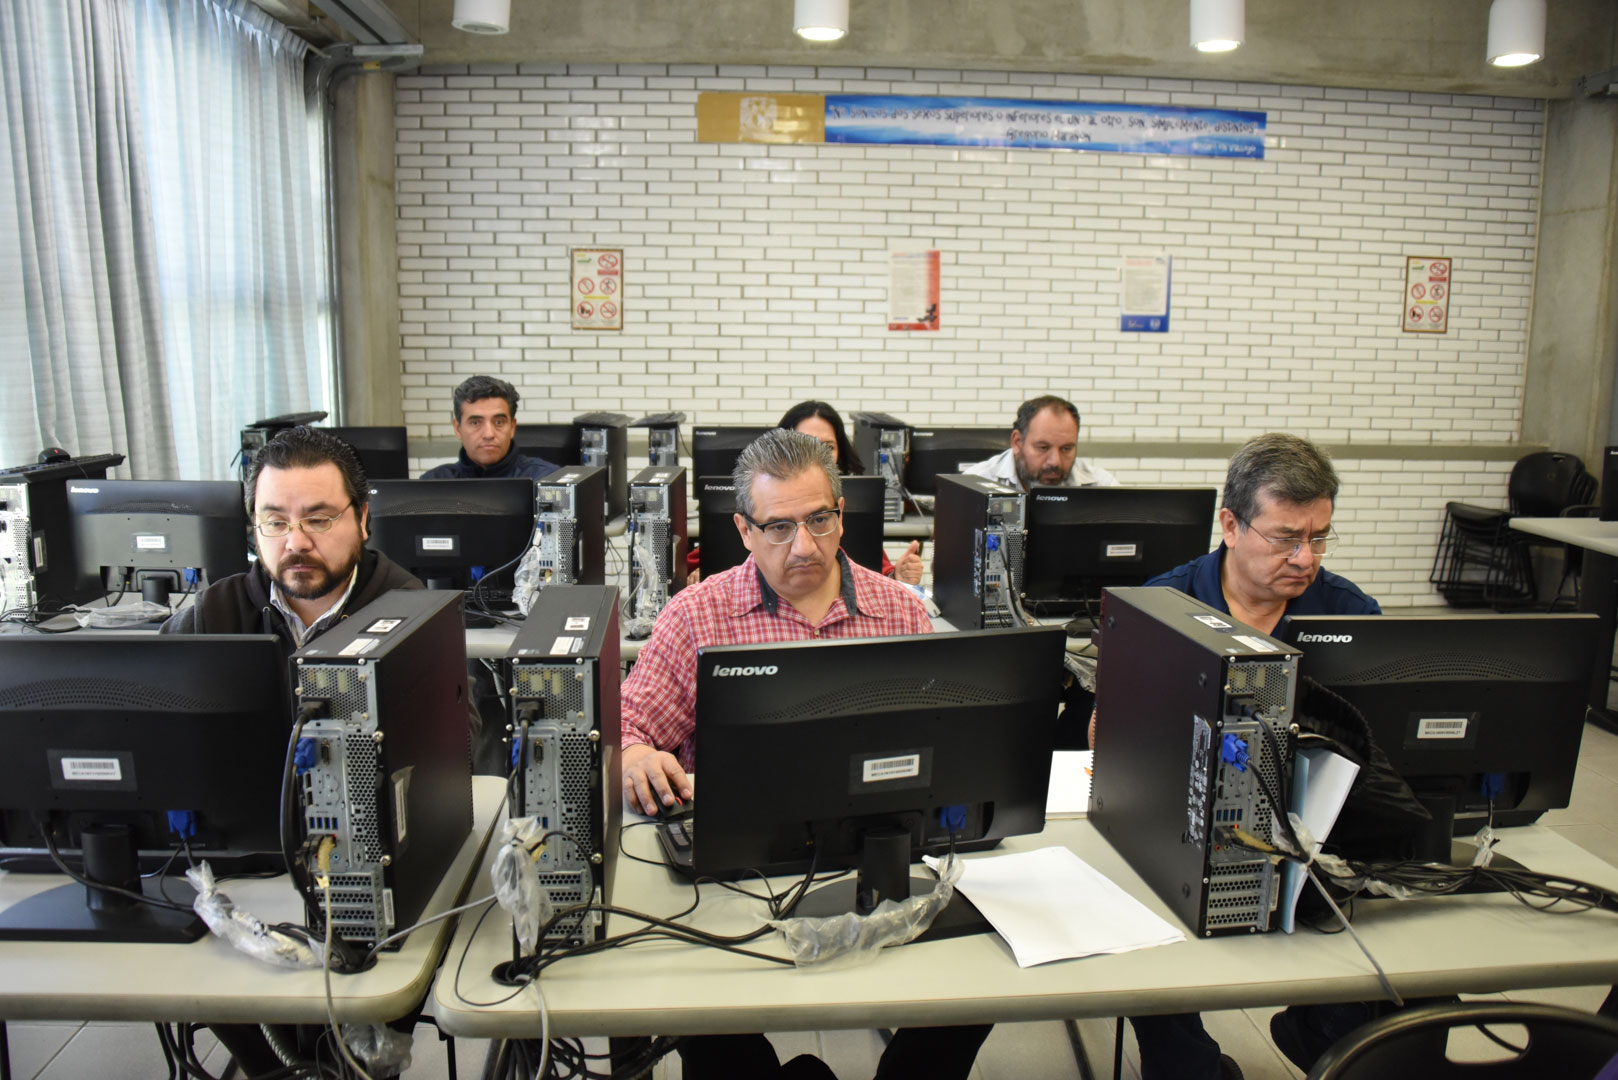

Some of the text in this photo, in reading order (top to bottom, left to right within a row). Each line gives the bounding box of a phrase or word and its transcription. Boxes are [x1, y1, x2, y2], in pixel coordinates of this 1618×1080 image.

[1036, 494, 1069, 502] lenovo
[1296, 631, 1353, 643] lenovo
[712, 664, 779, 677] lenovo
